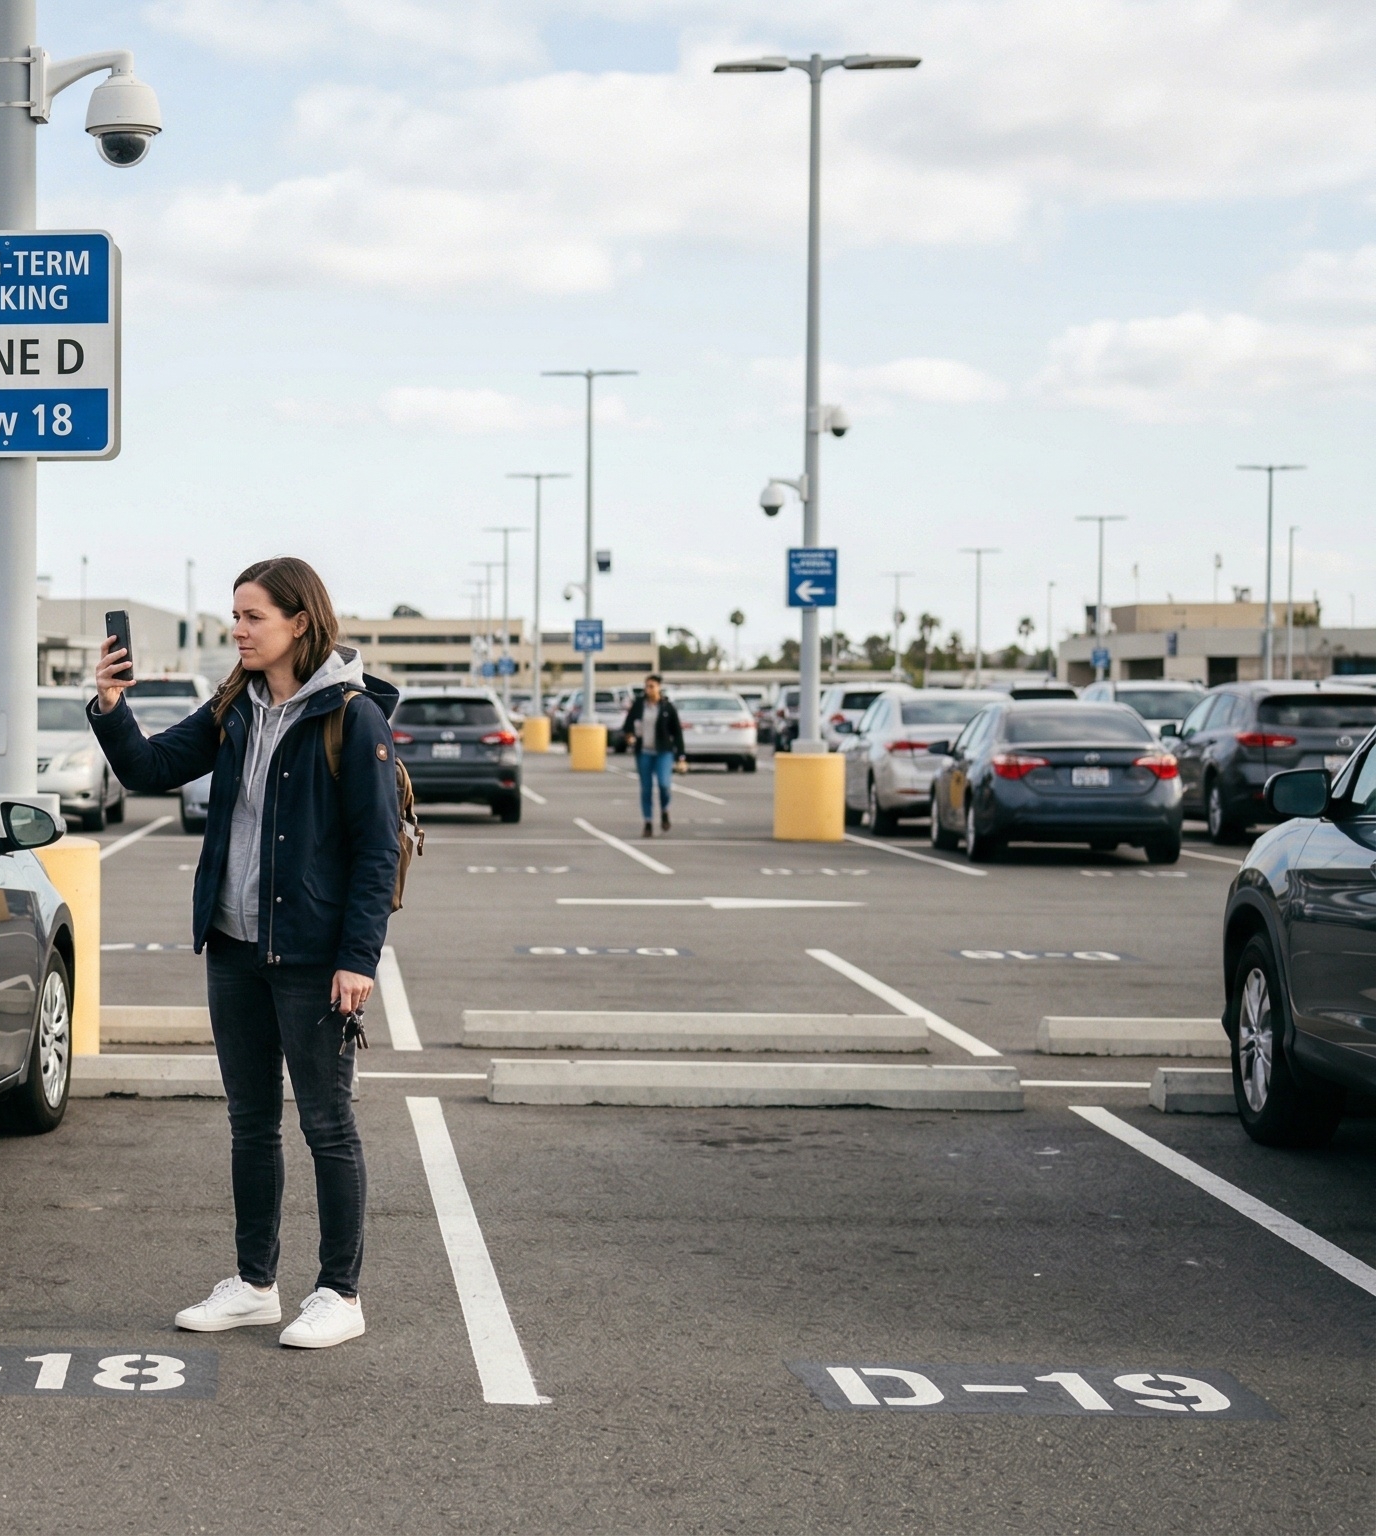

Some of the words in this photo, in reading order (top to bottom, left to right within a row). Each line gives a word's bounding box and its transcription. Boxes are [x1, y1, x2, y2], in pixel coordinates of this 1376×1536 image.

[57, 338, 85, 375] D
[31, 403, 73, 436] 18
[826, 1367, 1231, 1412] D-19
